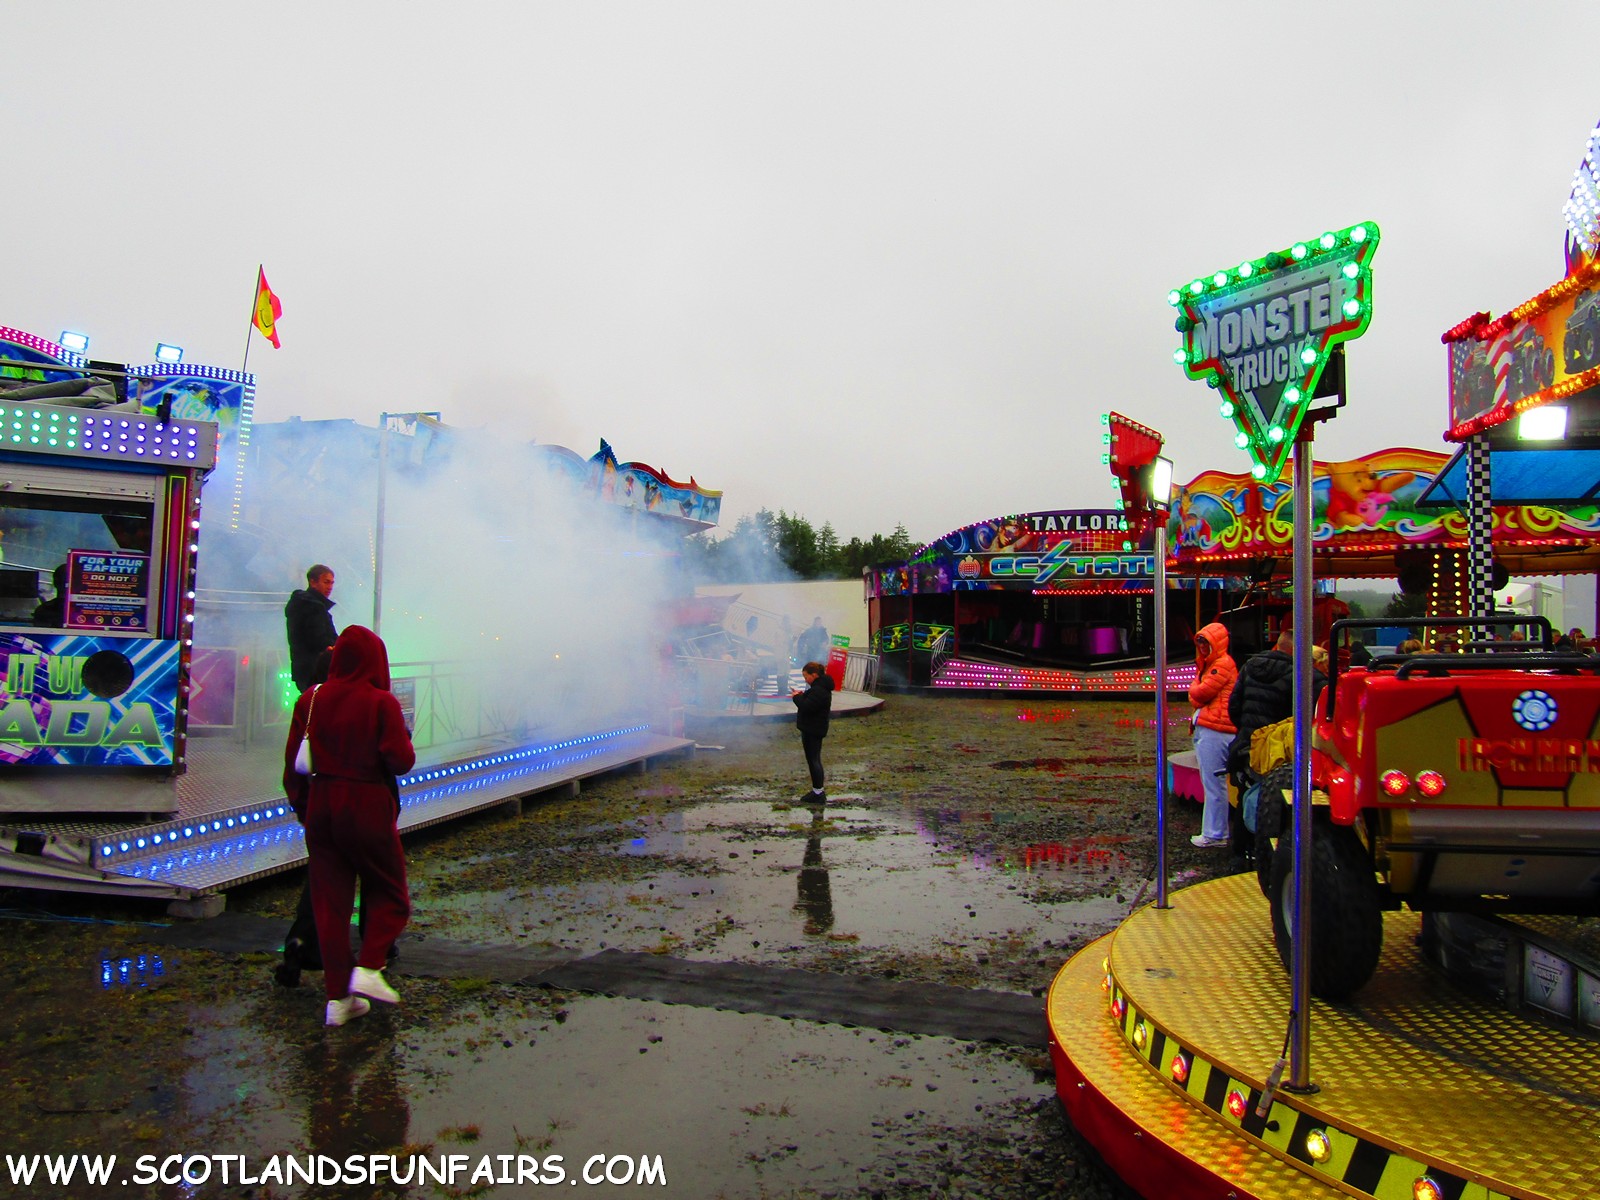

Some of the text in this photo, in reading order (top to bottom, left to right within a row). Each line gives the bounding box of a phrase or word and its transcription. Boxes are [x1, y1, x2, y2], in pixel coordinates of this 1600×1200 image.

[1230, 340, 1306, 393] TRUCK
[79, 556, 144, 567] FOR YOUR
[83, 564, 138, 574] SAFETY!
[990, 540, 1155, 584] ECSTATI
[7, 653, 40, 694] IT
